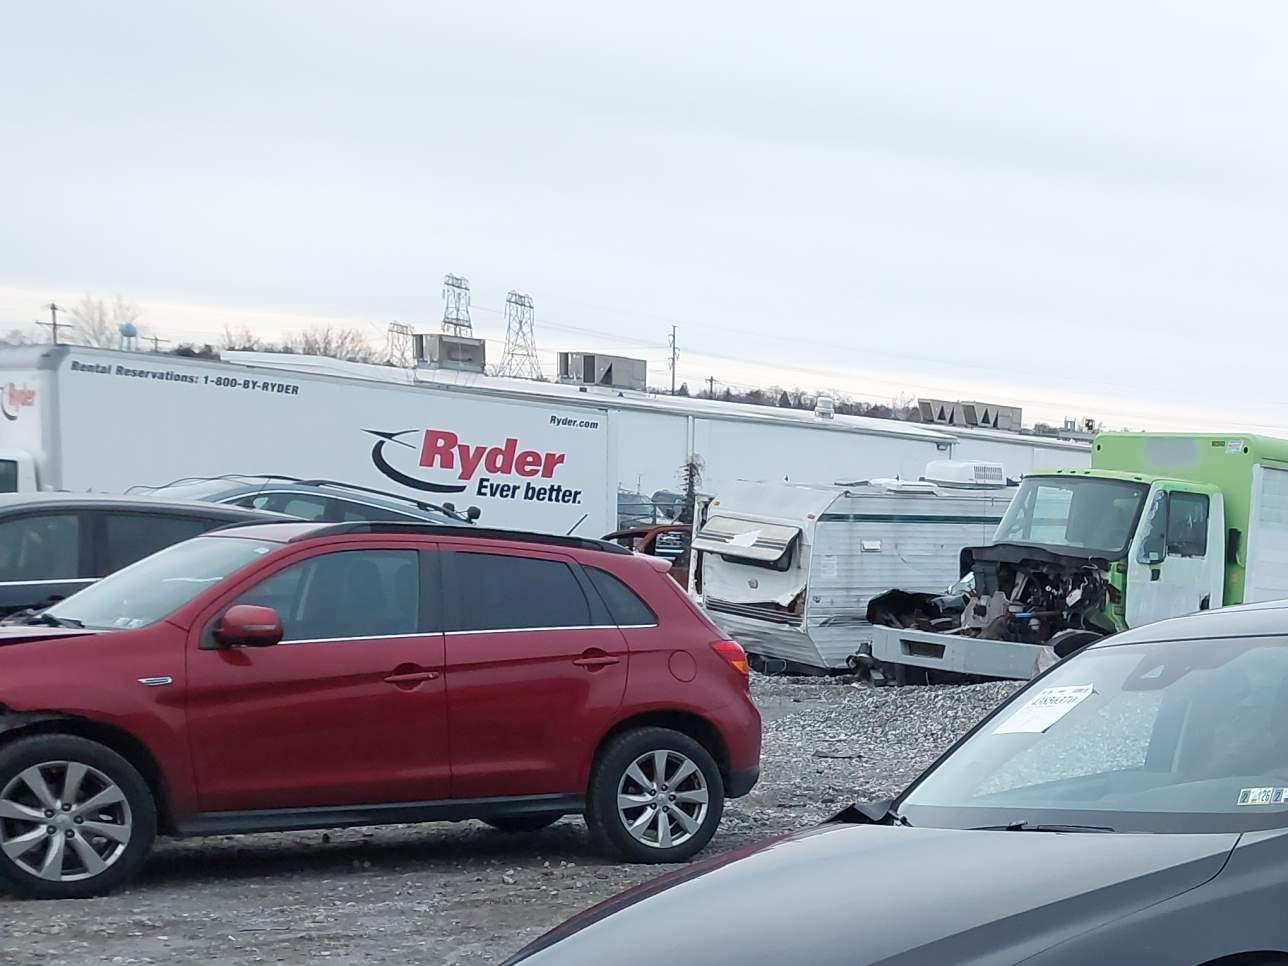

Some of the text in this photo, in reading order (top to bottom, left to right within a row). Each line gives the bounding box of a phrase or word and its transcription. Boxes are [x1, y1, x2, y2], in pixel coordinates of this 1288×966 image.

[71, 361, 299, 395] Rental Reservations: 1-800-BY-RYDER
[550, 415, 598, 429] Ryder.com
[419, 429, 565, 480] Ryder
[476, 478, 582, 504] Ever better.
